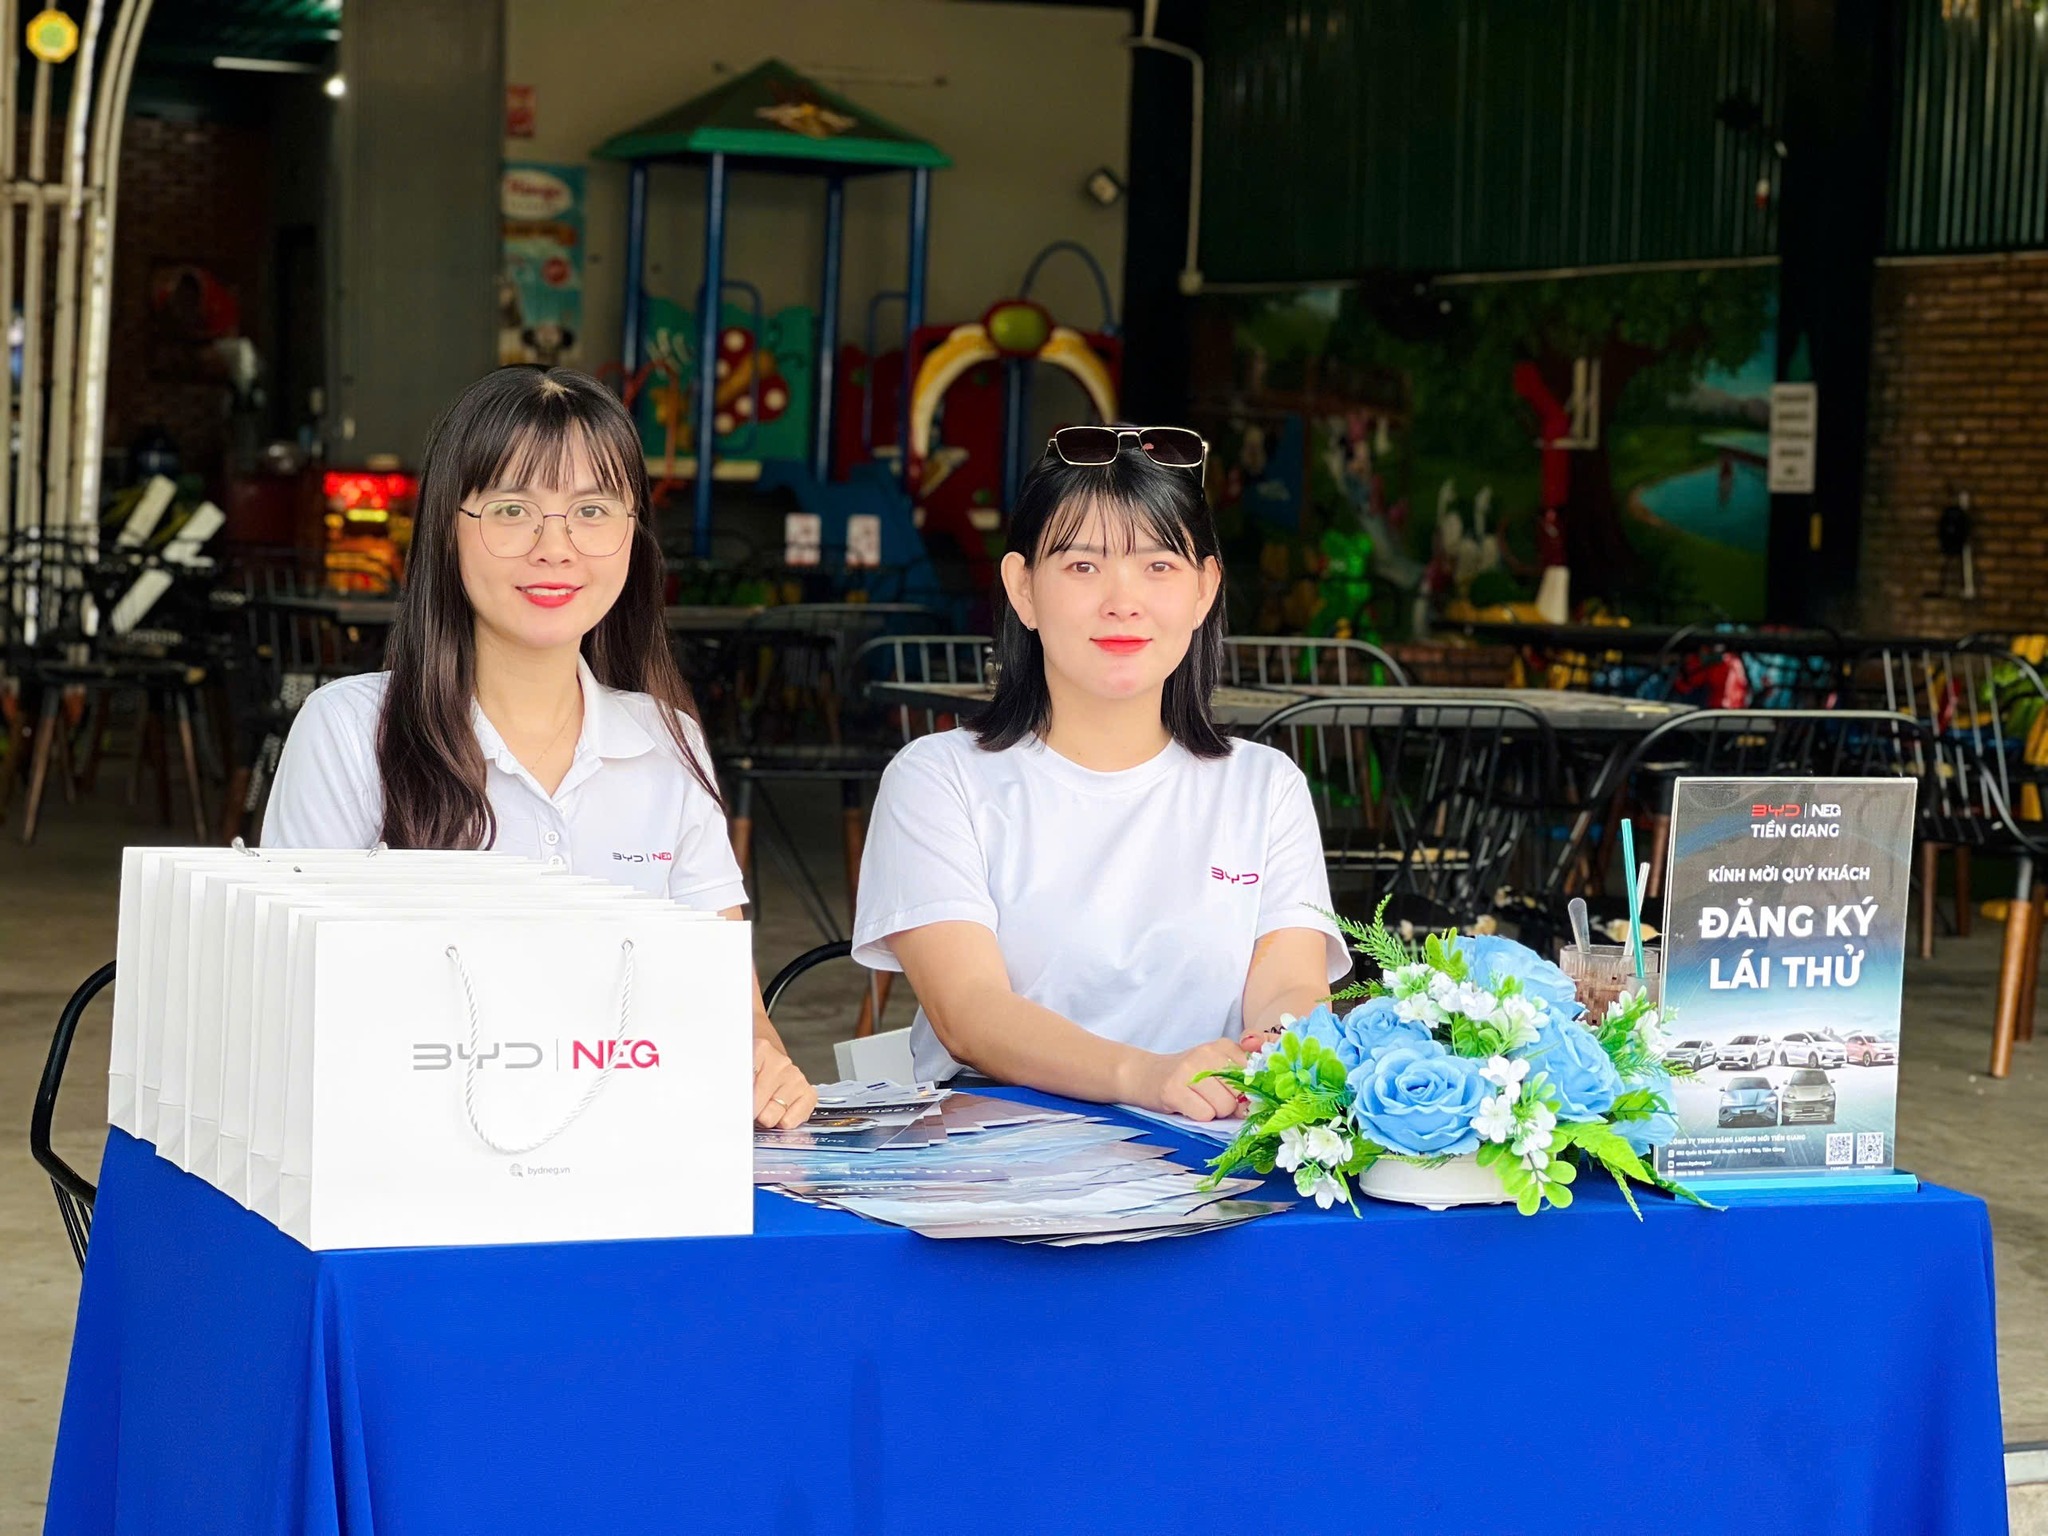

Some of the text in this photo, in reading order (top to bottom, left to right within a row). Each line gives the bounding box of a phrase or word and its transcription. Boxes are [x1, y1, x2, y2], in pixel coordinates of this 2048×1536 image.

[1751, 803, 1842, 818] BYD NEG
[1750, 820, 1840, 838] TIỀN GIANG
[612, 852, 644, 863] BYD
[1211, 866, 1259, 885] BYD
[1708, 864, 1871, 884] KÍNH MỜI QUÝ KHÁCH
[1698, 895, 1879, 939] ĐĂNG KÝ
[1709, 943, 1865, 990] LÁI THỬ
[412, 1039, 660, 1071] BYD NEG
[527, 1165, 571, 1176] bydneg.vn
